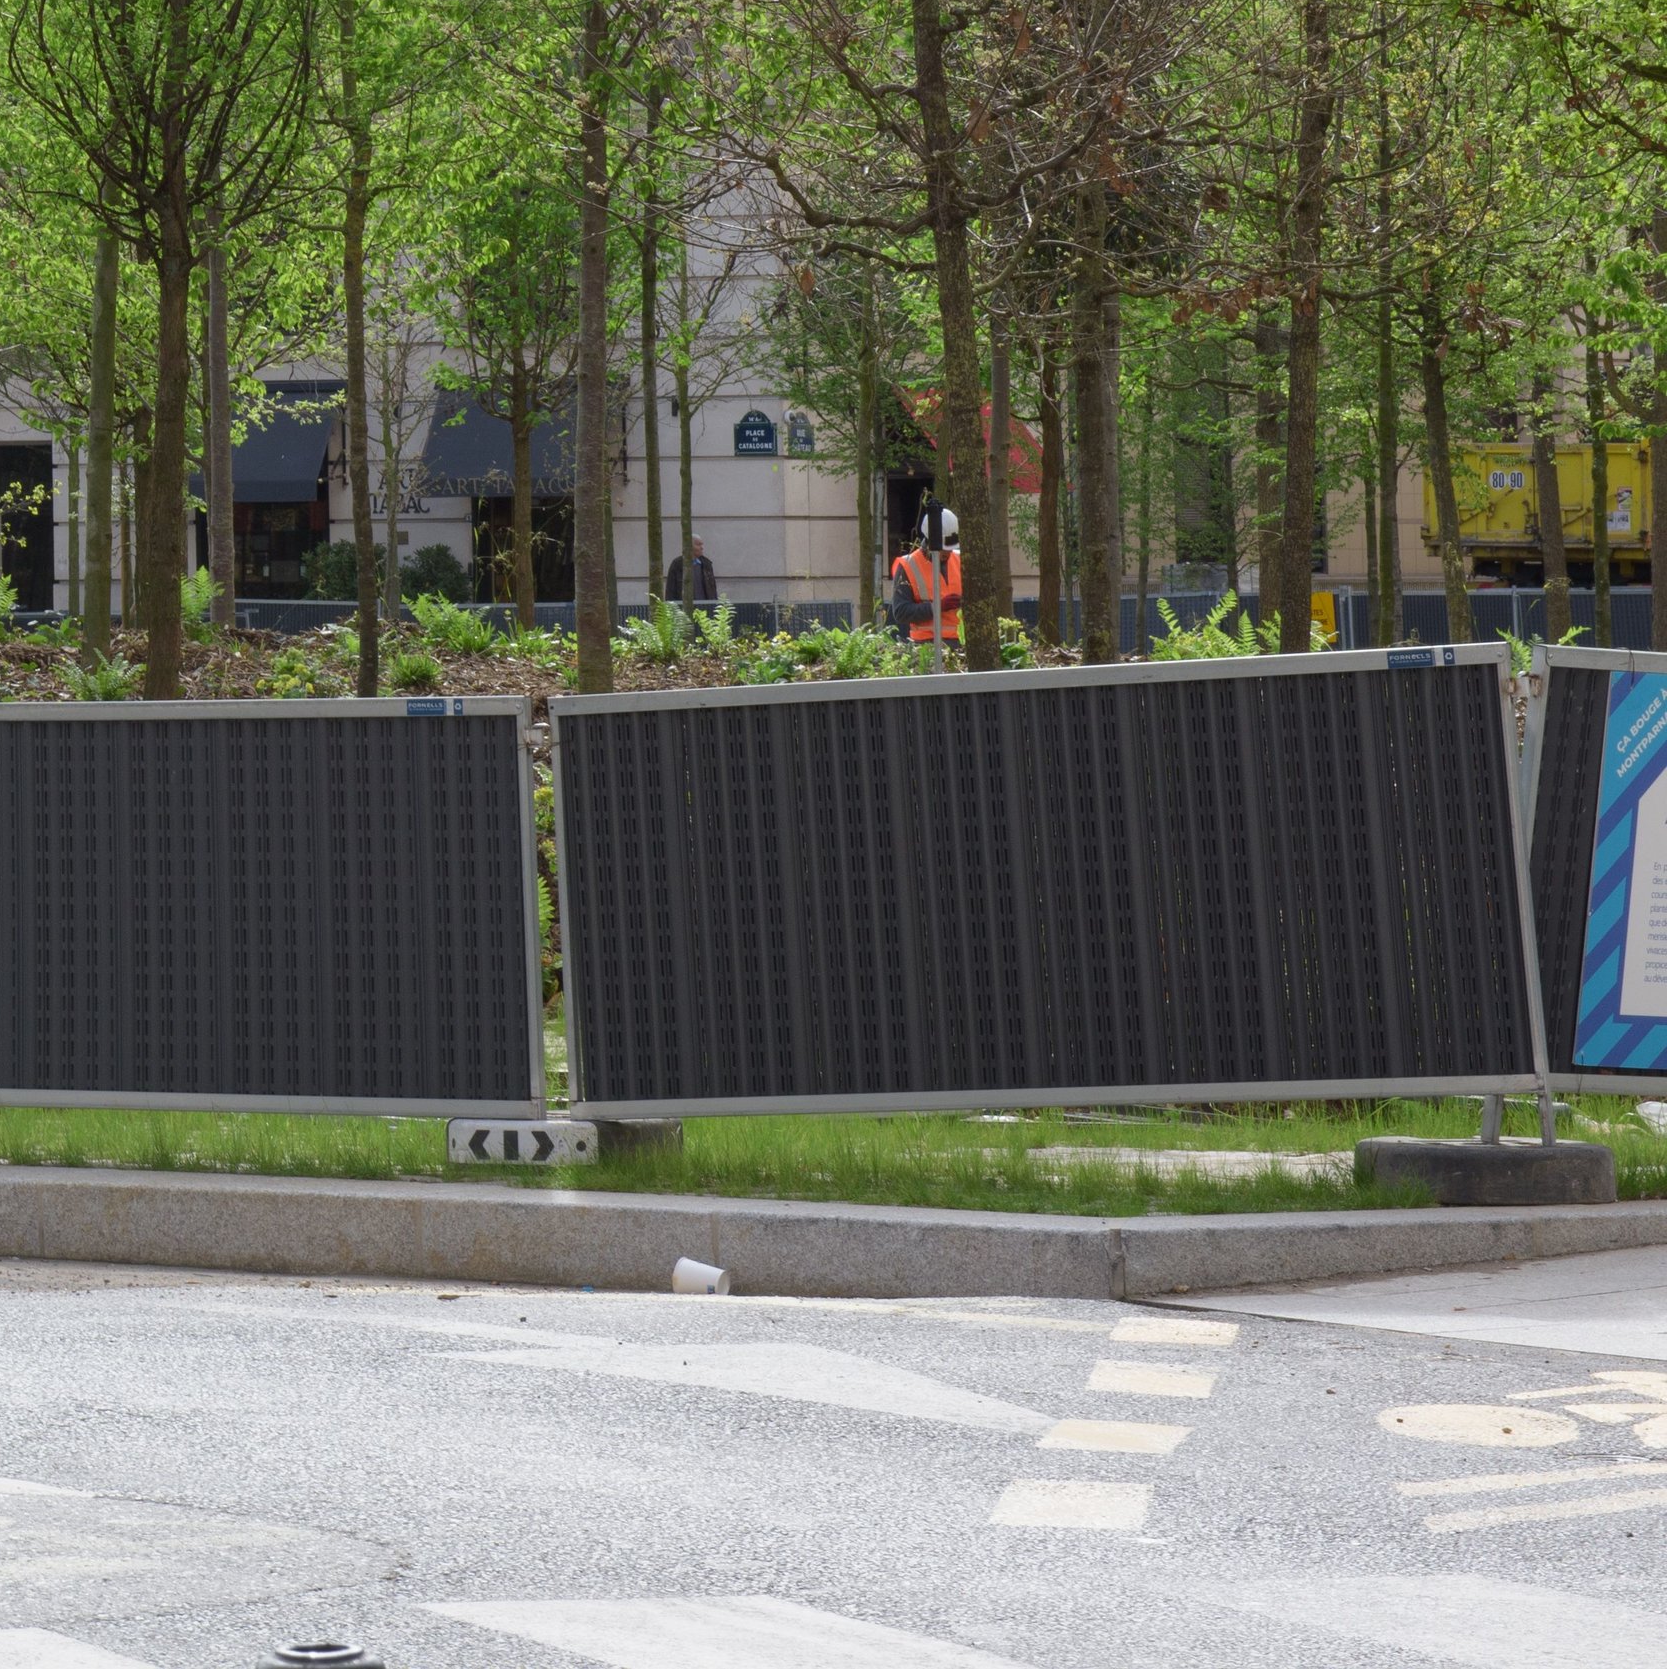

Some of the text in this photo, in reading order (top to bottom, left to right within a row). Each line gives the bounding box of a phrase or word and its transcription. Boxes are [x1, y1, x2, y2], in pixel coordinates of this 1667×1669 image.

[745, 429, 765, 437] PLACE
[738, 442, 773, 450] CATALOGNE
[441, 477, 481, 494] ART
[1492, 472, 1523, 488] 80 90
[1389, 653, 1431, 661] FORNELLS
[1616, 735, 1632, 753] ÇA
[1630, 697, 1662, 737] BOUGE
